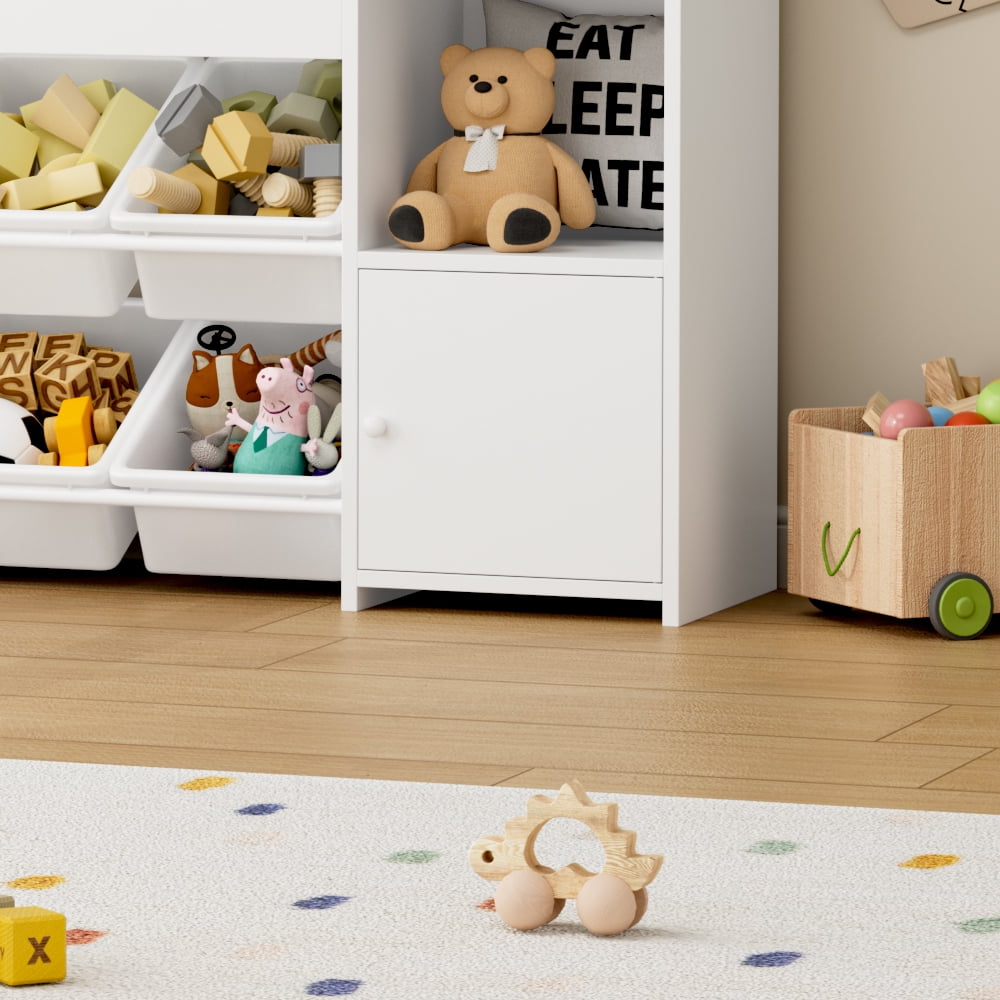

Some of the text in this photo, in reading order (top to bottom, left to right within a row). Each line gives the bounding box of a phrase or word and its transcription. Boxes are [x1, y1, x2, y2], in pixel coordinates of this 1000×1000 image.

[546, 21, 645, 60] EAT
[582, 158, 664, 211] ATE
[41, 353, 87, 381] K
[27, 936, 51, 965] X
